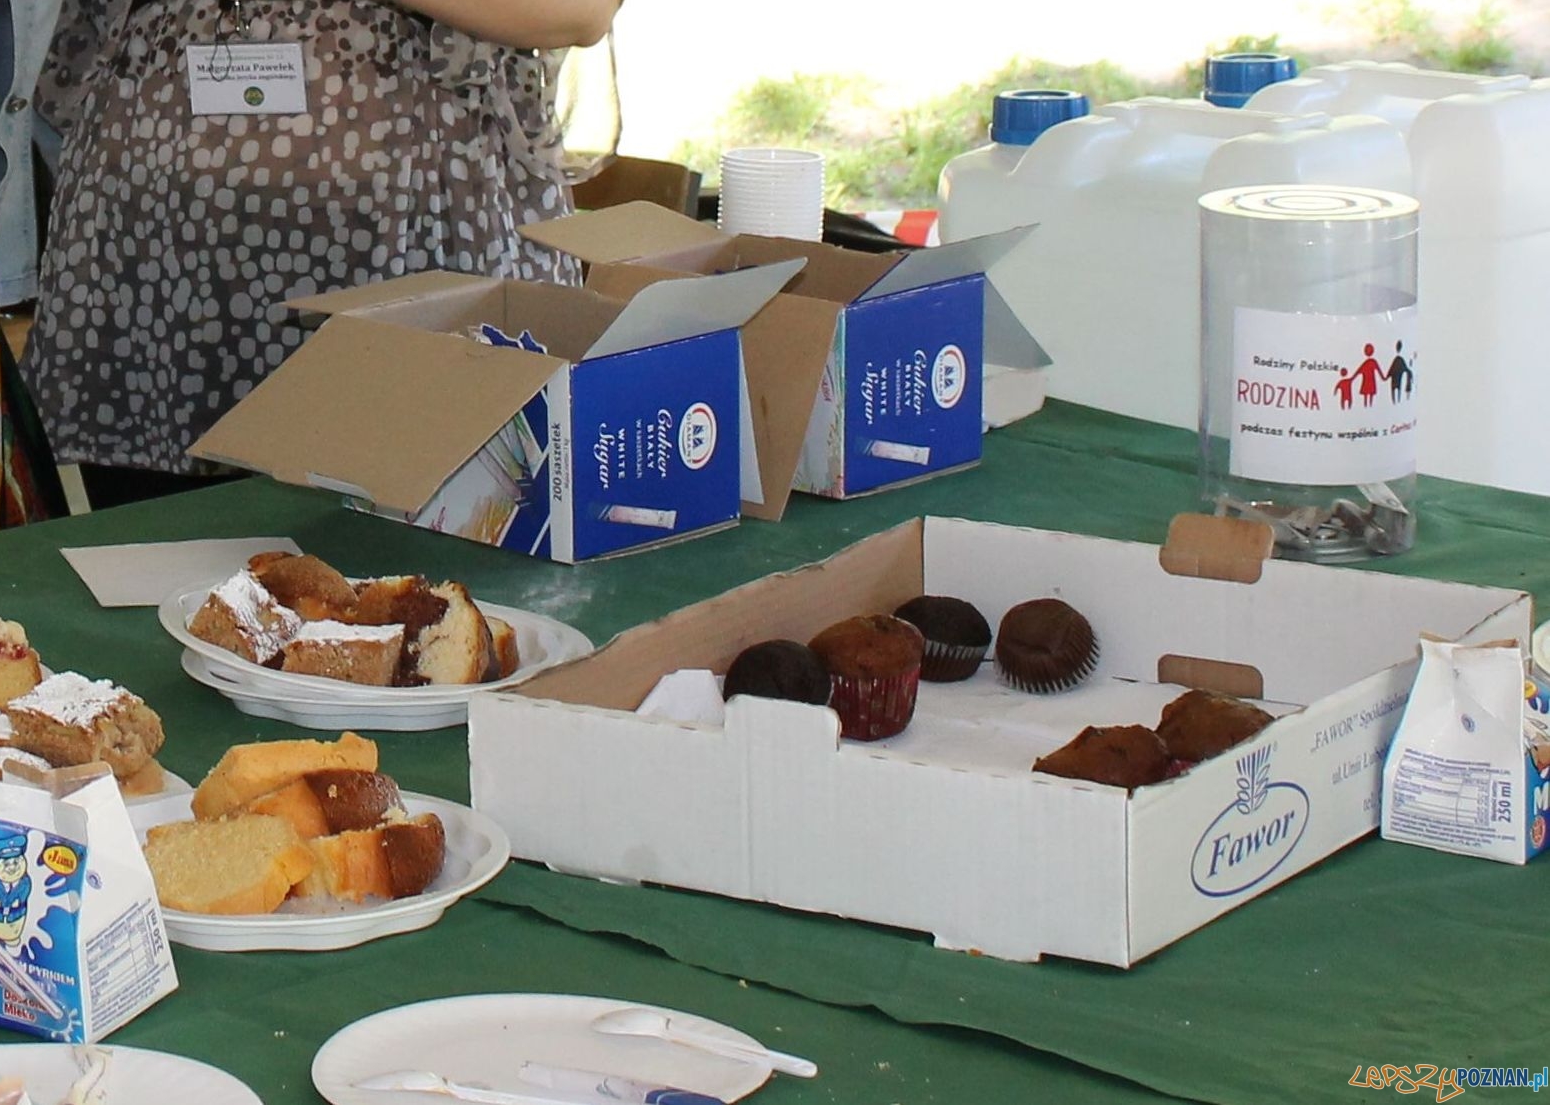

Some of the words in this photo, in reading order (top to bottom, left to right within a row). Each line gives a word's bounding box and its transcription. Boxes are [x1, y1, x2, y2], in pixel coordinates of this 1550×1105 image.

[1253, 356, 1295, 371] Rodziny
[1300, 360, 1339, 371] Polskie
[861, 362, 879, 425] Sugar
[913, 350, 927, 415] Cukier
[1237, 378, 1320, 410] RODZINA
[657, 409, 673, 478] Cukier
[1240, 423, 1283, 436] podczas
[1289, 427, 1333, 441] festynu
[1338, 428, 1378, 441] wspólnie
[551, 422, 562, 476] saszetek
[593, 423, 615, 490] Sugar
[618, 428, 626, 479] WHITE
[553, 478, 562, 502] 200
[1498, 781, 1511, 797] ml
[1498, 800, 1511, 823] 250
[1207, 810, 1295, 878] Fawor
[153, 928, 164, 952] 250
[4, 1002, 35, 1022] Mleko
